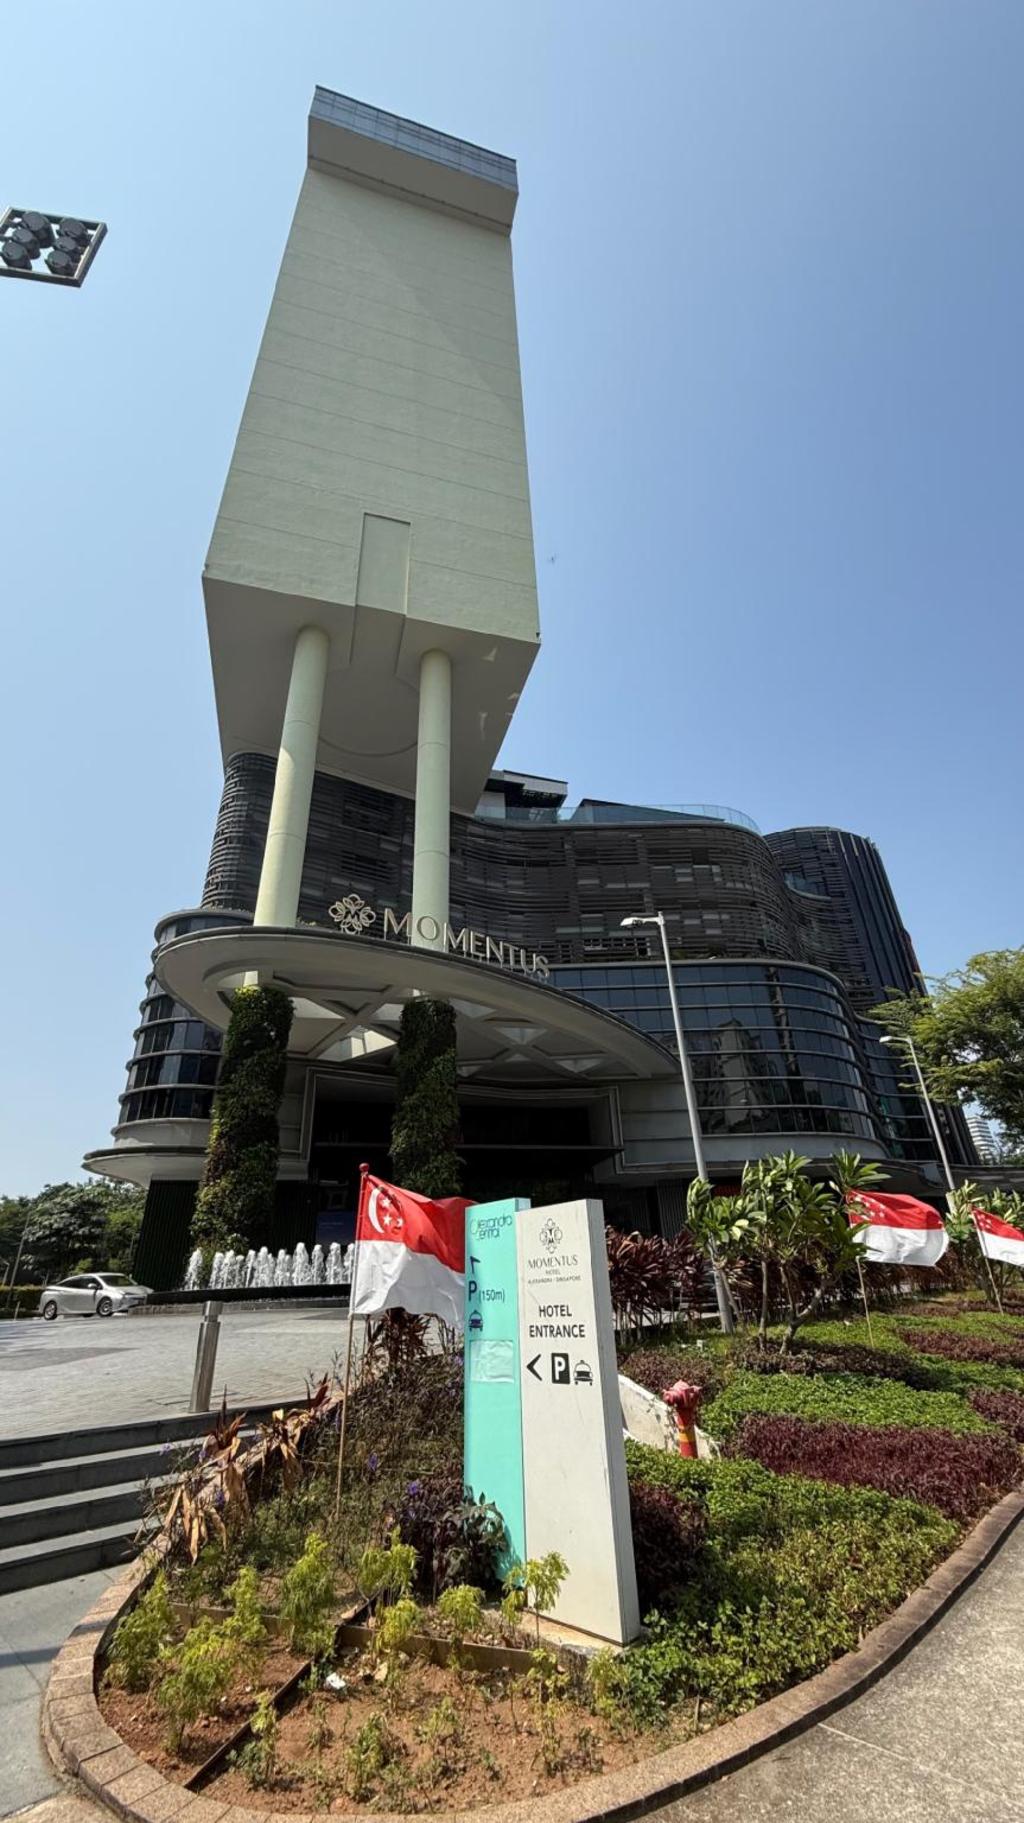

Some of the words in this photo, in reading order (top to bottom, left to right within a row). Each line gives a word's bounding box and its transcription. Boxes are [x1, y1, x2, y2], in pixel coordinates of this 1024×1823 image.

[383, 908, 550, 977] MOMENTUS
[528, 1254, 579, 1268] MOMENTUS
[468, 1280, 478, 1303] P
[479, 1288, 505, 1304] (150m)
[538, 1305, 573, 1318] HOTEL
[529, 1324, 586, 1338] ENTRANCE
[554, 1357, 566, 1379] P
